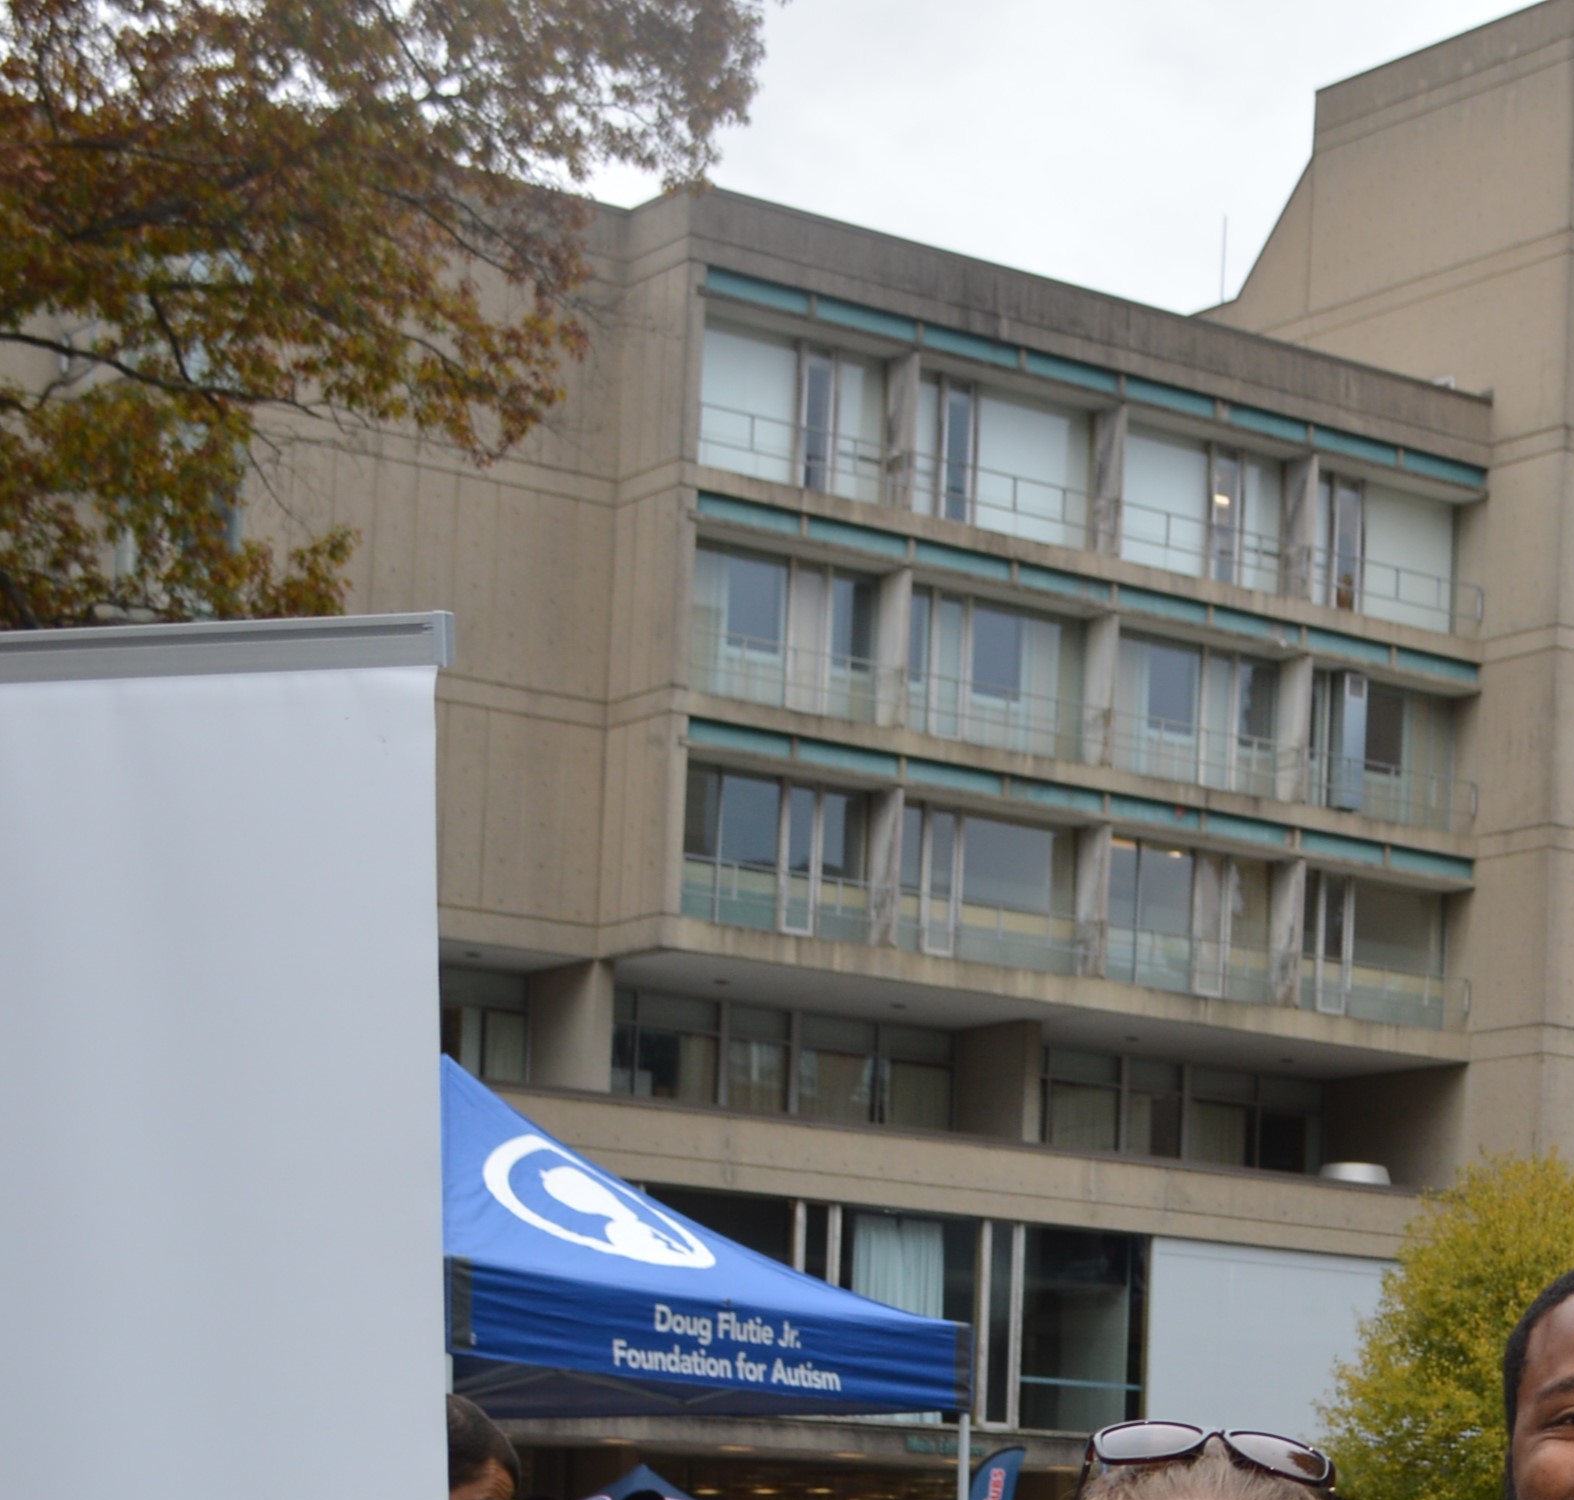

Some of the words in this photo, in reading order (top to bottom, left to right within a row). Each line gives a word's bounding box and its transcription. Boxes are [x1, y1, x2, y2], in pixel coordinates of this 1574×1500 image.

[654, 1303, 712, 1346] Doug
[717, 1312, 774, 1346] Flutie
[777, 1320, 802, 1349] Jr.
[612, 1338, 732, 1380] Foundation
[735, 1351, 767, 1383] for
[771, 1357, 842, 1392] Autism
